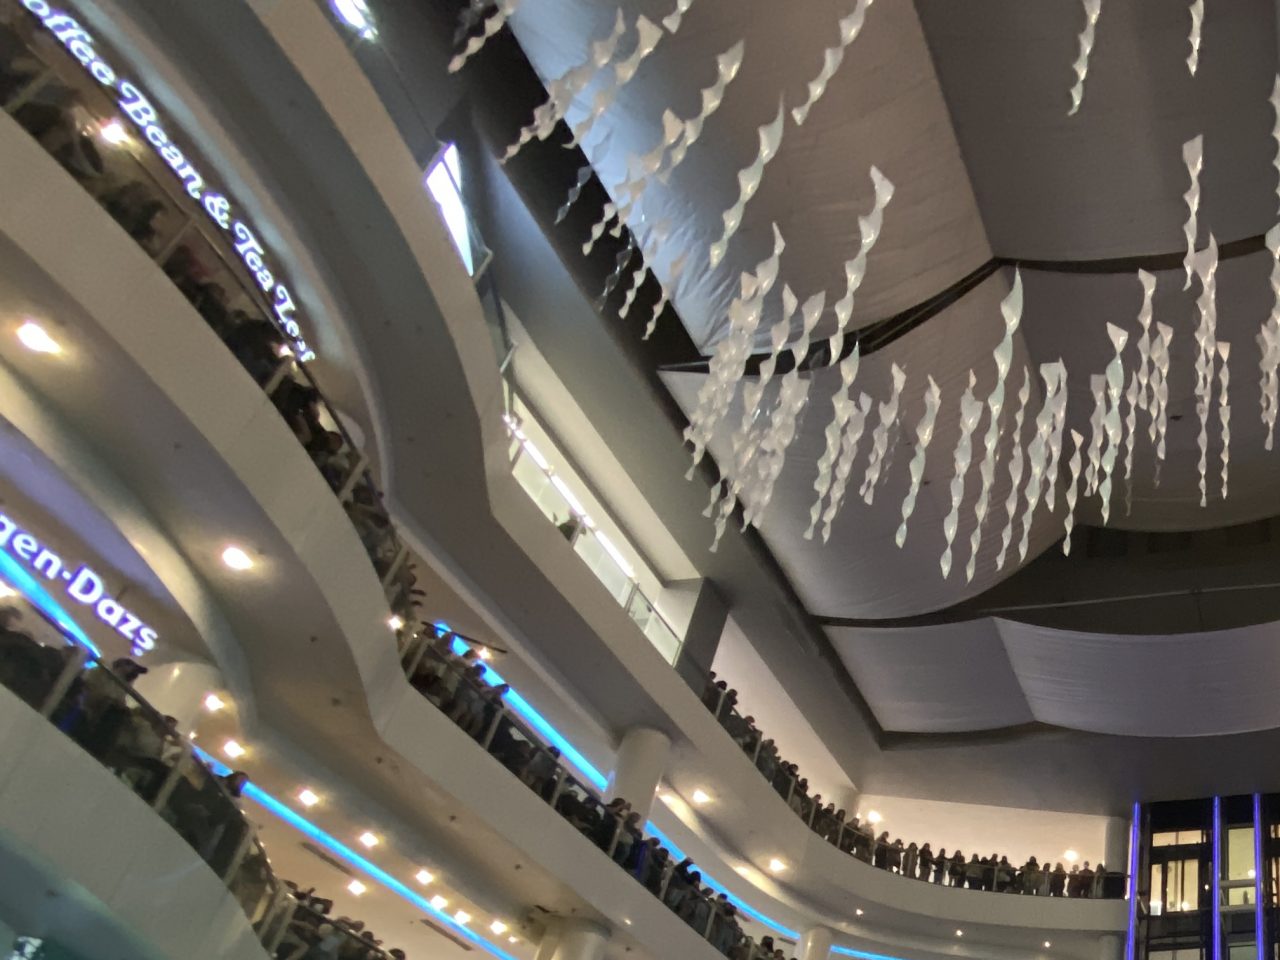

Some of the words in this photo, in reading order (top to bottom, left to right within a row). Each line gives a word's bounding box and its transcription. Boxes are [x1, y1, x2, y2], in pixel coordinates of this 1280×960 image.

[118, 80, 205, 200] Bean
[202, 191, 230, 230] &
[234, 221, 273, 292] Tea
